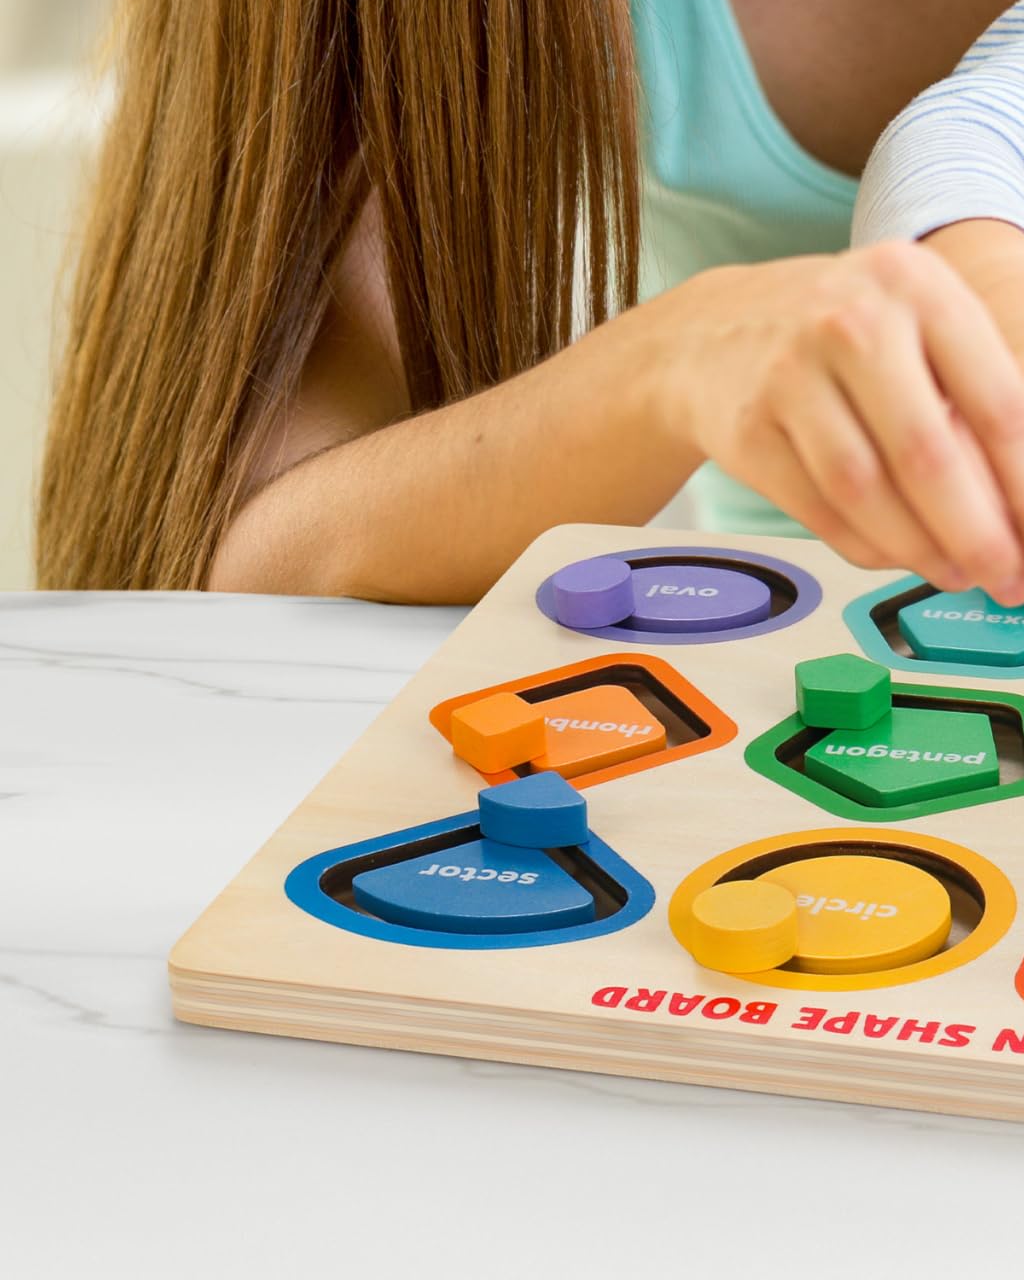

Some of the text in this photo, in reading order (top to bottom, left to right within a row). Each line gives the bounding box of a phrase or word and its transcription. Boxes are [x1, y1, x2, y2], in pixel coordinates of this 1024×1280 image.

[646, 584, 719, 598] oval
[543, 715, 655, 738] rhomb
[824, 744, 987, 765] pentagon
[418, 863, 540, 885] sector
[796, 894, 899, 921] circle
[590, 986, 778, 1025] BOARD
[791, 1006, 977, 1048] SHAPE
